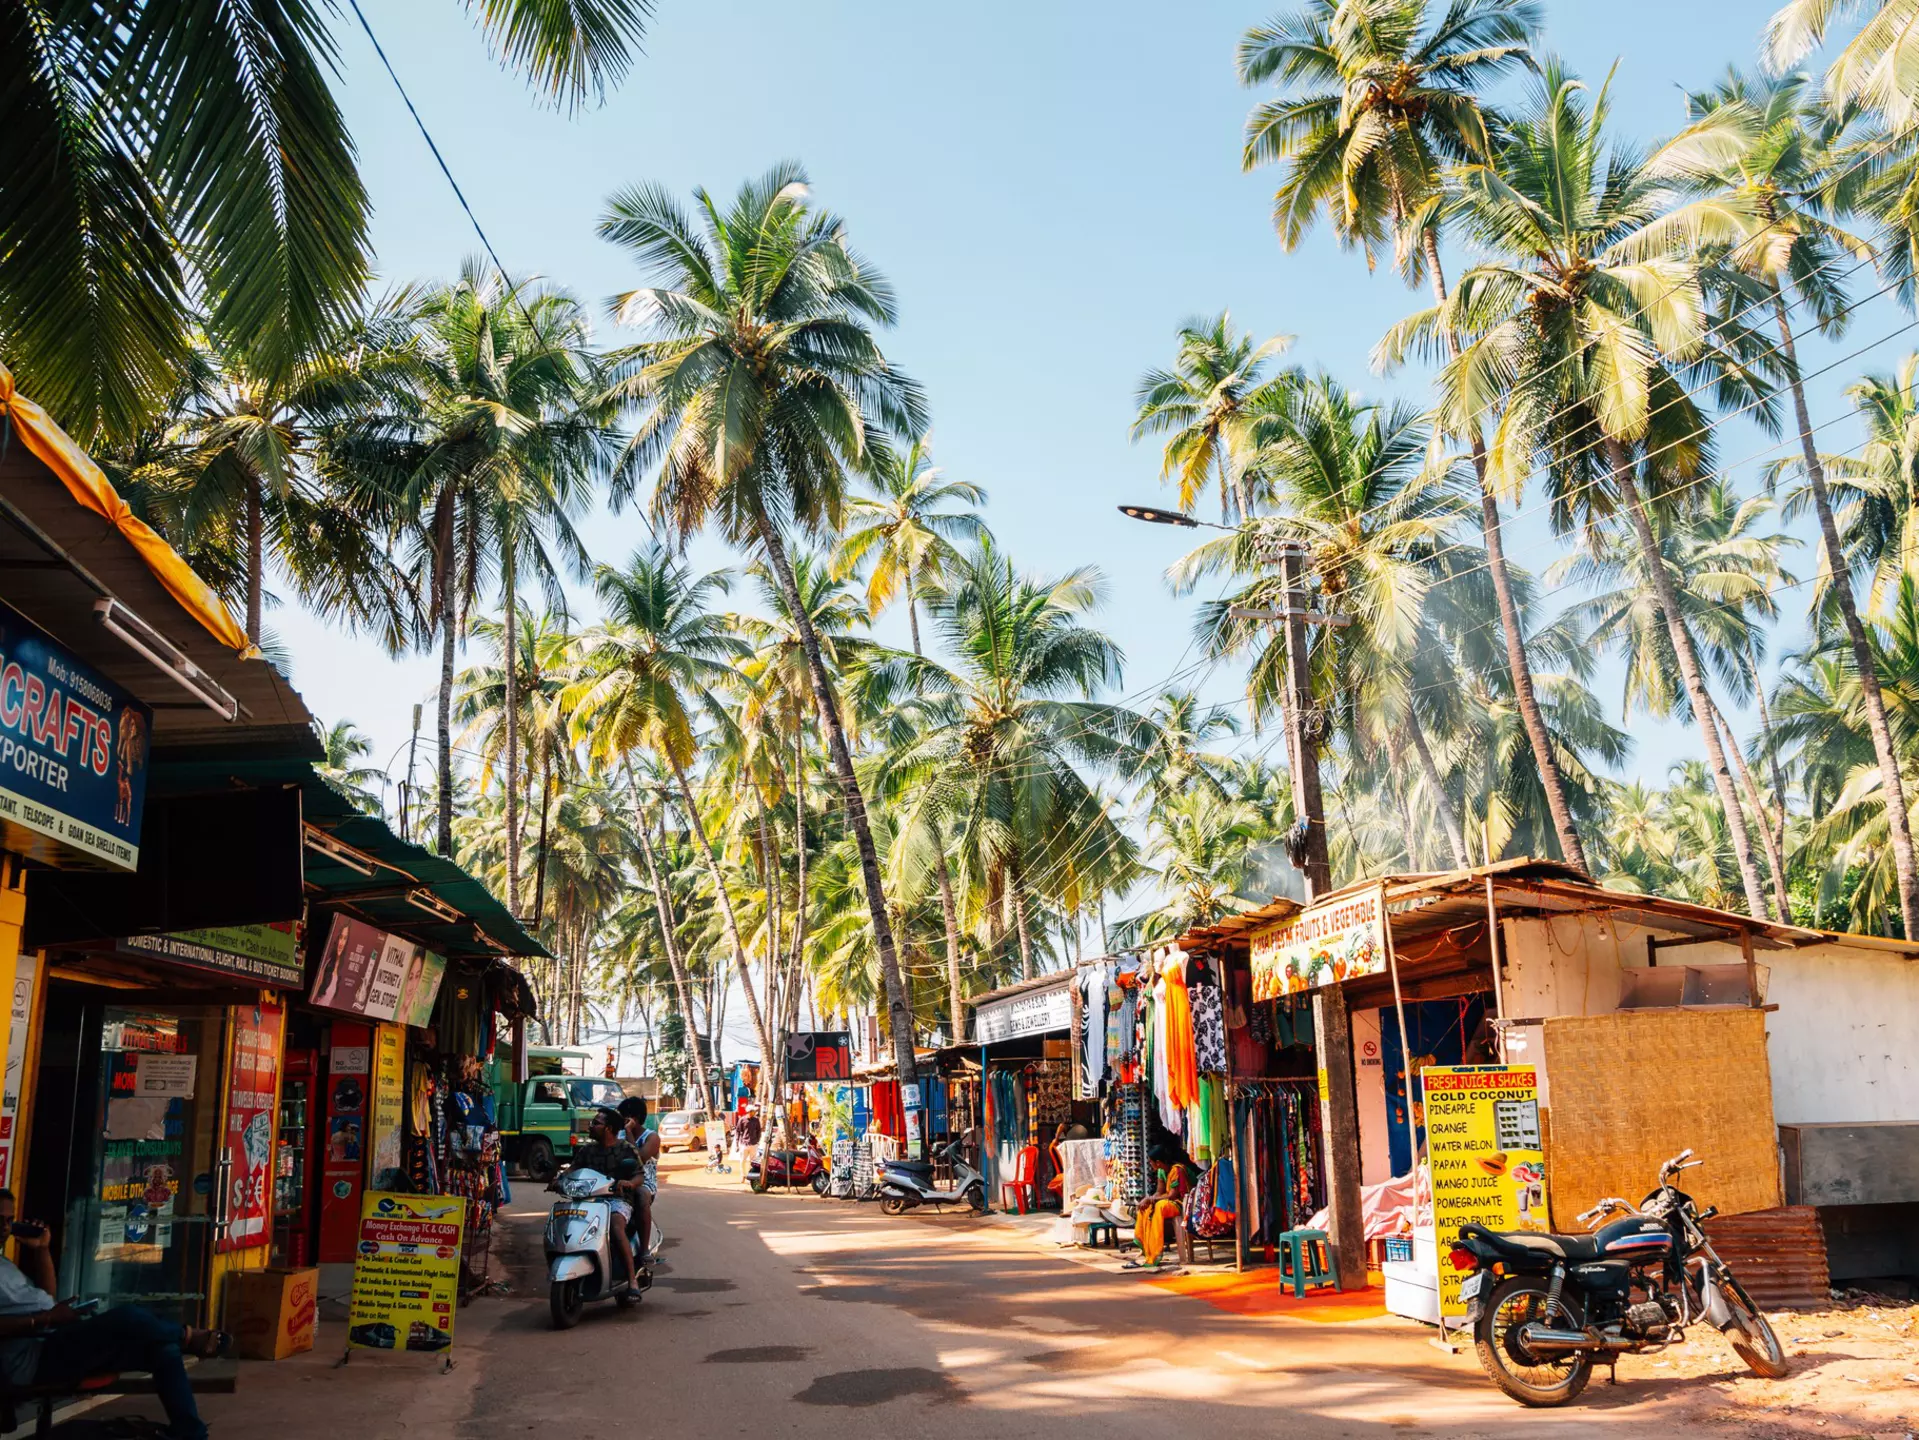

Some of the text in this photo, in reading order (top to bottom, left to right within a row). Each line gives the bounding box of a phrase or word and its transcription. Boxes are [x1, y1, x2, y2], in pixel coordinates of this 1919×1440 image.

[48, 656, 68, 684] Mob:
[0, 795, 131, 862] TANT, TELSCOPE & GOAN SEA SHELLS ITEMS
[1295, 917, 1321, 946] FRUITS
[1323, 914, 1328, 935] &
[1330, 898, 1376, 932] VEGETABLE
[216, 929, 239, 948] Internet
[127, 935, 162, 952] DOMESTIC
[162, 939, 168, 953] &
[169, 940, 215, 963] INTERNATIONAL
[235, 955, 248, 971] RAIL
[253, 960, 263, 974] BUS
[263, 963, 279, 978] TICKET
[279, 966, 299, 983] BOOKING
[381, 991, 397, 1009] STORE
[114, 1072, 136, 1091] MON
[1427, 1072, 1534, 1089] FRESH JUICE & SHAKES
[1431, 1090, 1533, 1102] COLD COCONUT
[1429, 1103, 1476, 1115] PINEAPPLE
[1431, 1122, 1467, 1134] ORANGE
[1433, 1140, 1493, 1152] WATER MELON
[1434, 1160, 1467, 1170] PAPAYA
[1436, 1176, 1498, 1190] MANGO JUICE
[103, 1184, 129, 1201] MOBILE
[1437, 1195, 1503, 1209] POMEGRANATE
[365, 1220, 456, 1235] Money Exchange TC & CASH
[1438, 1215, 1505, 1228] MIXED FRUITS
[376, 1232, 443, 1245] Cash On Advance
[1442, 1275, 1464, 1286] STRA
